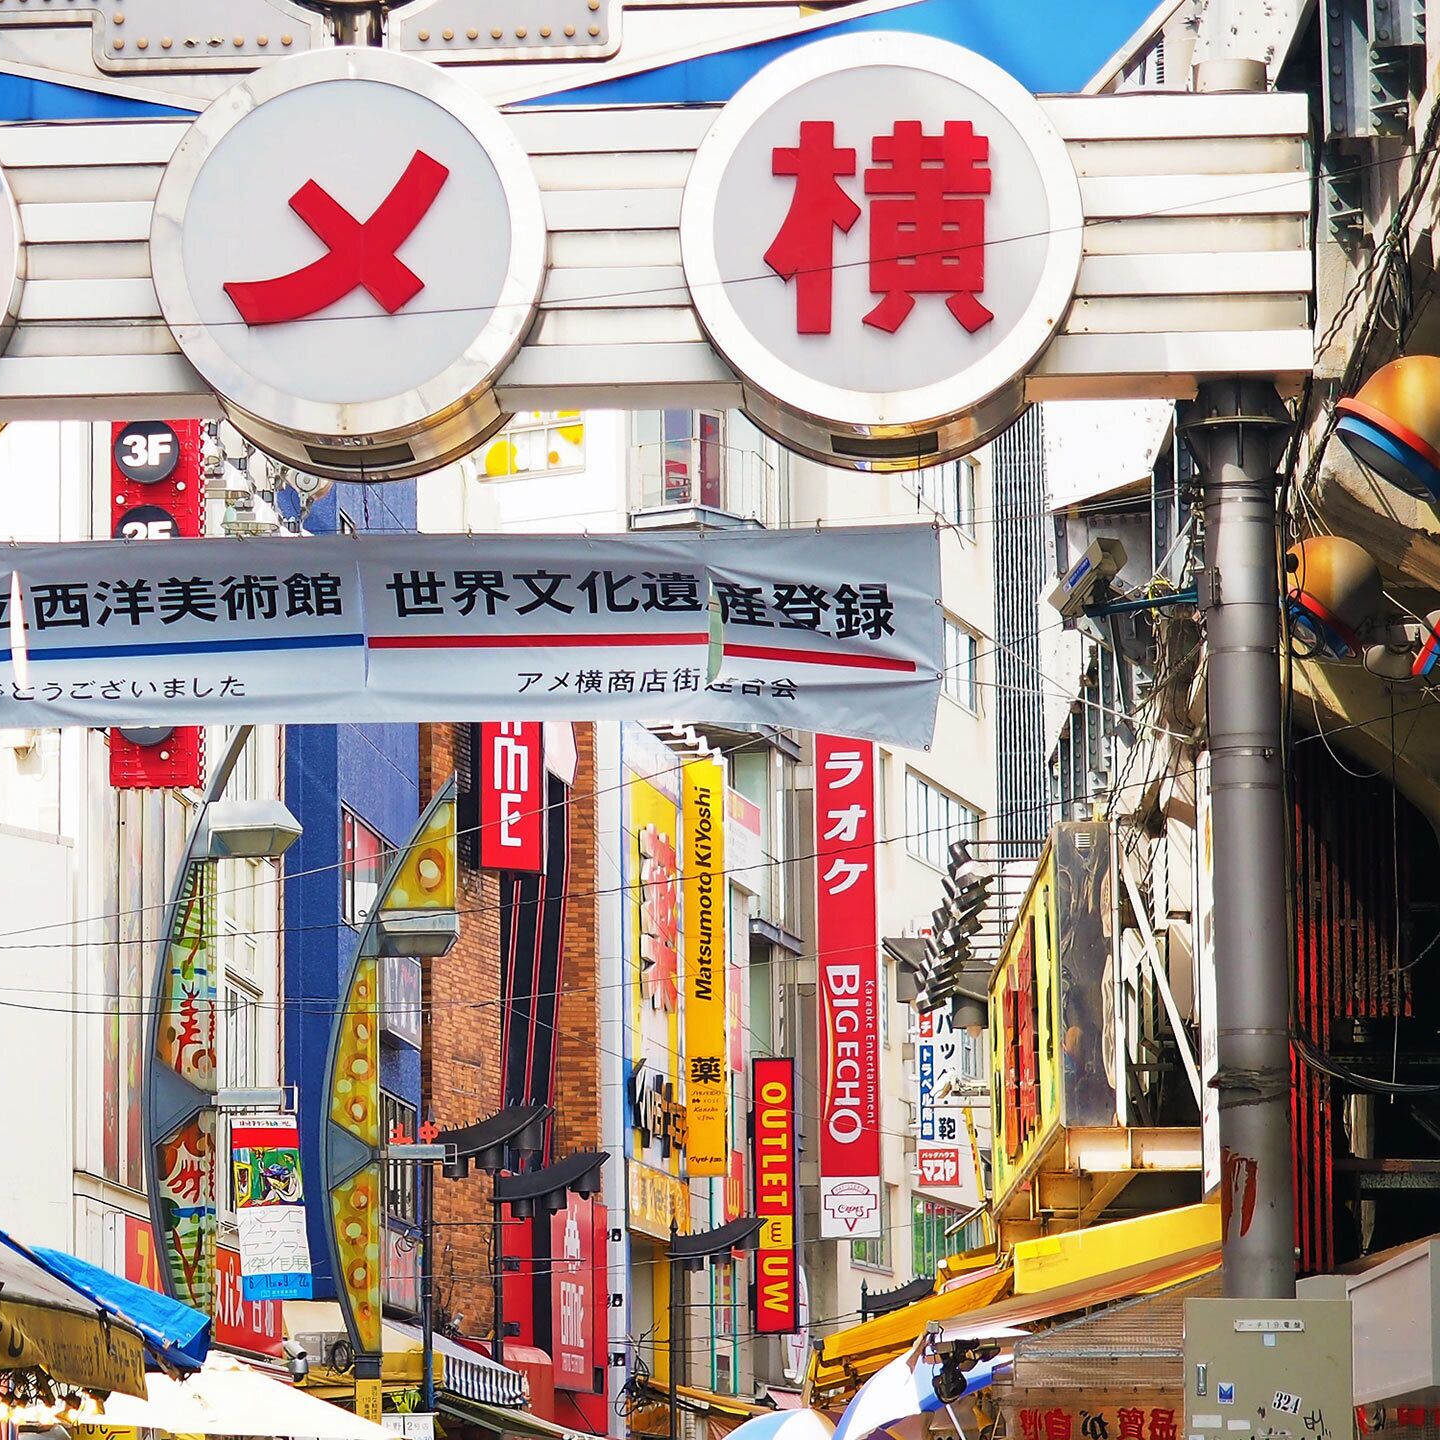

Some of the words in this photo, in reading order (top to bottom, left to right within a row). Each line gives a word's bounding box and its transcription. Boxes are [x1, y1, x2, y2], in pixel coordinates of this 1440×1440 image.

[121, 433, 173, 467] 3F
[385, 569, 896, 641] 世界文化遺産登録
[823, 751, 869, 896] ラオケ
[694, 870, 712, 1001] Matsumoto
[825, 964, 860, 1033] BIG
[864, 979, 875, 1028] Karaoke
[690, 1057, 721, 1085] 薬
[828, 1041, 862, 1144] ECHO
[865, 1034, 876, 1124] Entertainment
[761, 1082, 789, 1207] OUTLET
[921, 1159, 957, 1182] マスヤ
[763, 1257, 789, 1313] UW
[1273, 1392, 1301, 1415] 324
